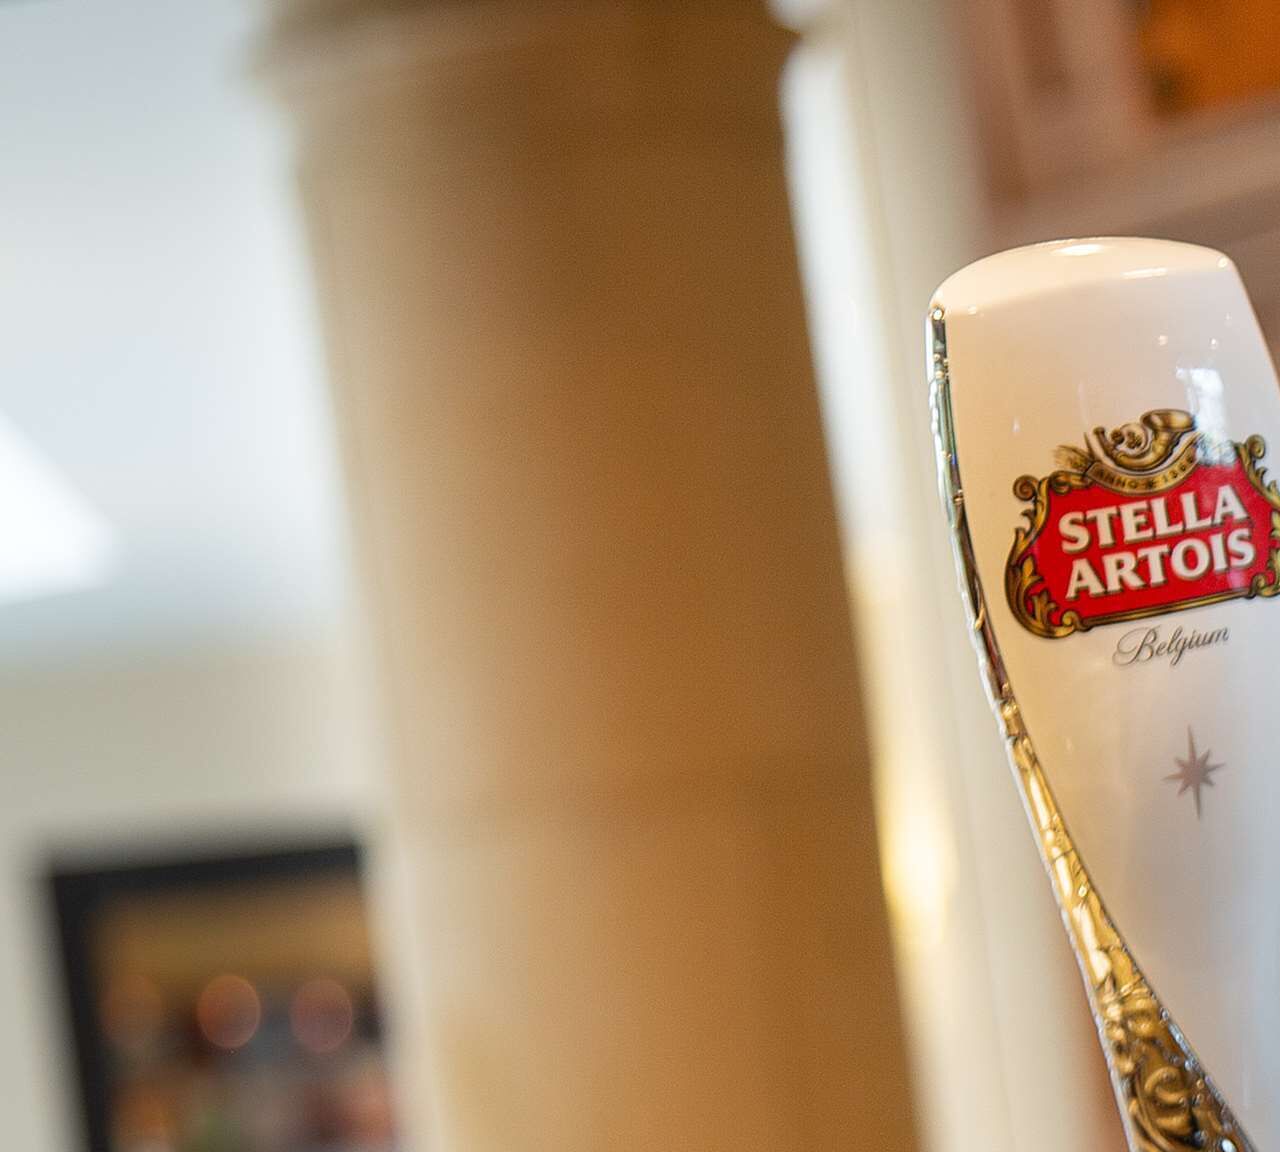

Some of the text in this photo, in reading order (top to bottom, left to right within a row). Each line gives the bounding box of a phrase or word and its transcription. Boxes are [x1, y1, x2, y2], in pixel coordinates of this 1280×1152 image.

[1058, 484, 1248, 552] STELLA
[1065, 528, 1256, 599] ARTOIS
[1112, 625, 1229, 666] Belgium
